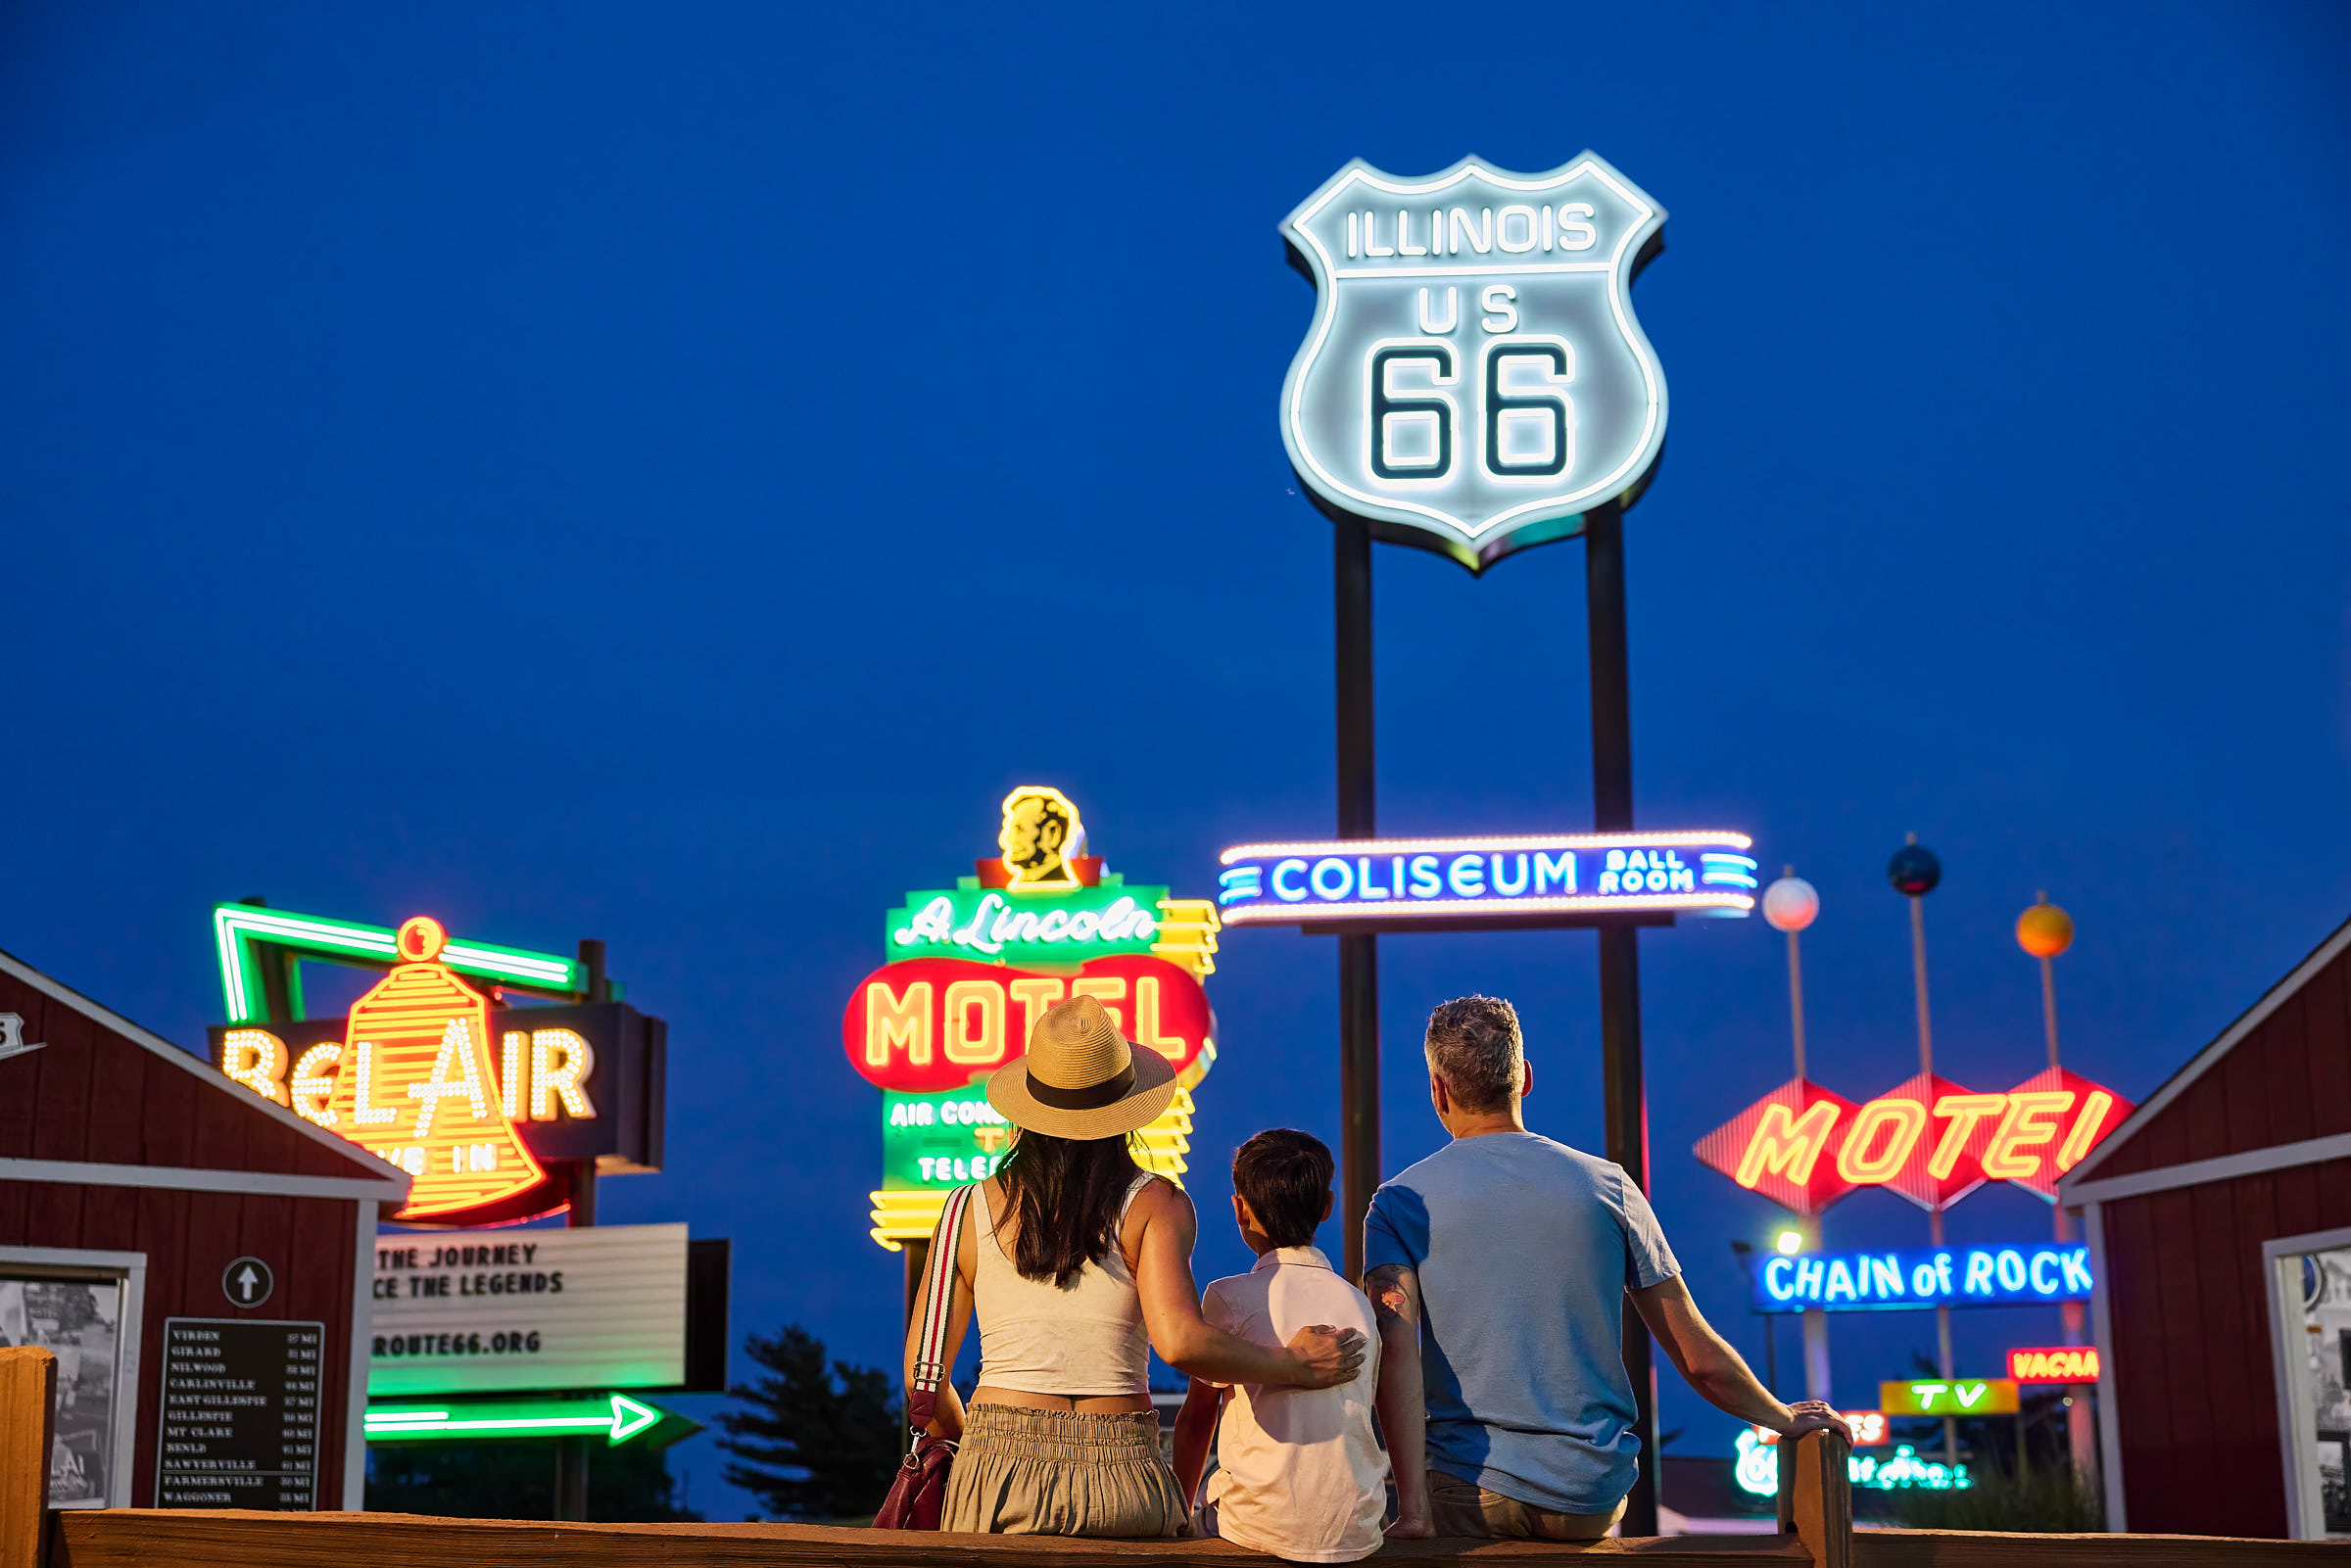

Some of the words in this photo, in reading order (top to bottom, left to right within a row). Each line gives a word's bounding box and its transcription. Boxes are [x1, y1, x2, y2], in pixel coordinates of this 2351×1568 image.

[1348, 202, 1597, 258] ILLINOIS
[1363, 334, 1576, 488] 66
[1605, 849, 1684, 871] BALL
[1271, 851, 1578, 902] COLISEUM
[1598, 868, 1695, 894] ROOM
[952, 893, 1157, 954] Lincoln
[889, 1101, 933, 1127] AIR
[452, 1143, 493, 1173] IN
[378, 1248, 418, 1270] THE
[428, 1243, 538, 1268] JOURNEY
[408, 1275, 451, 1298] THE
[460, 1270, 563, 1296] LEGENDS
[1765, 1254, 1905, 1302] CHAIN
[1911, 1252, 1952, 1297] of
[1965, 1247, 2094, 1296] ROCK
[172, 1330, 220, 1341] VIRDEN
[170, 1346, 221, 1357] GIRARD
[169, 1379, 256, 1391] CARLINVILLE
[190, 1427, 233, 1439] CLARE
[165, 1458, 257, 1470] SAWYERVILLE
[165, 1475, 264, 1487] FARMERSVILLE
